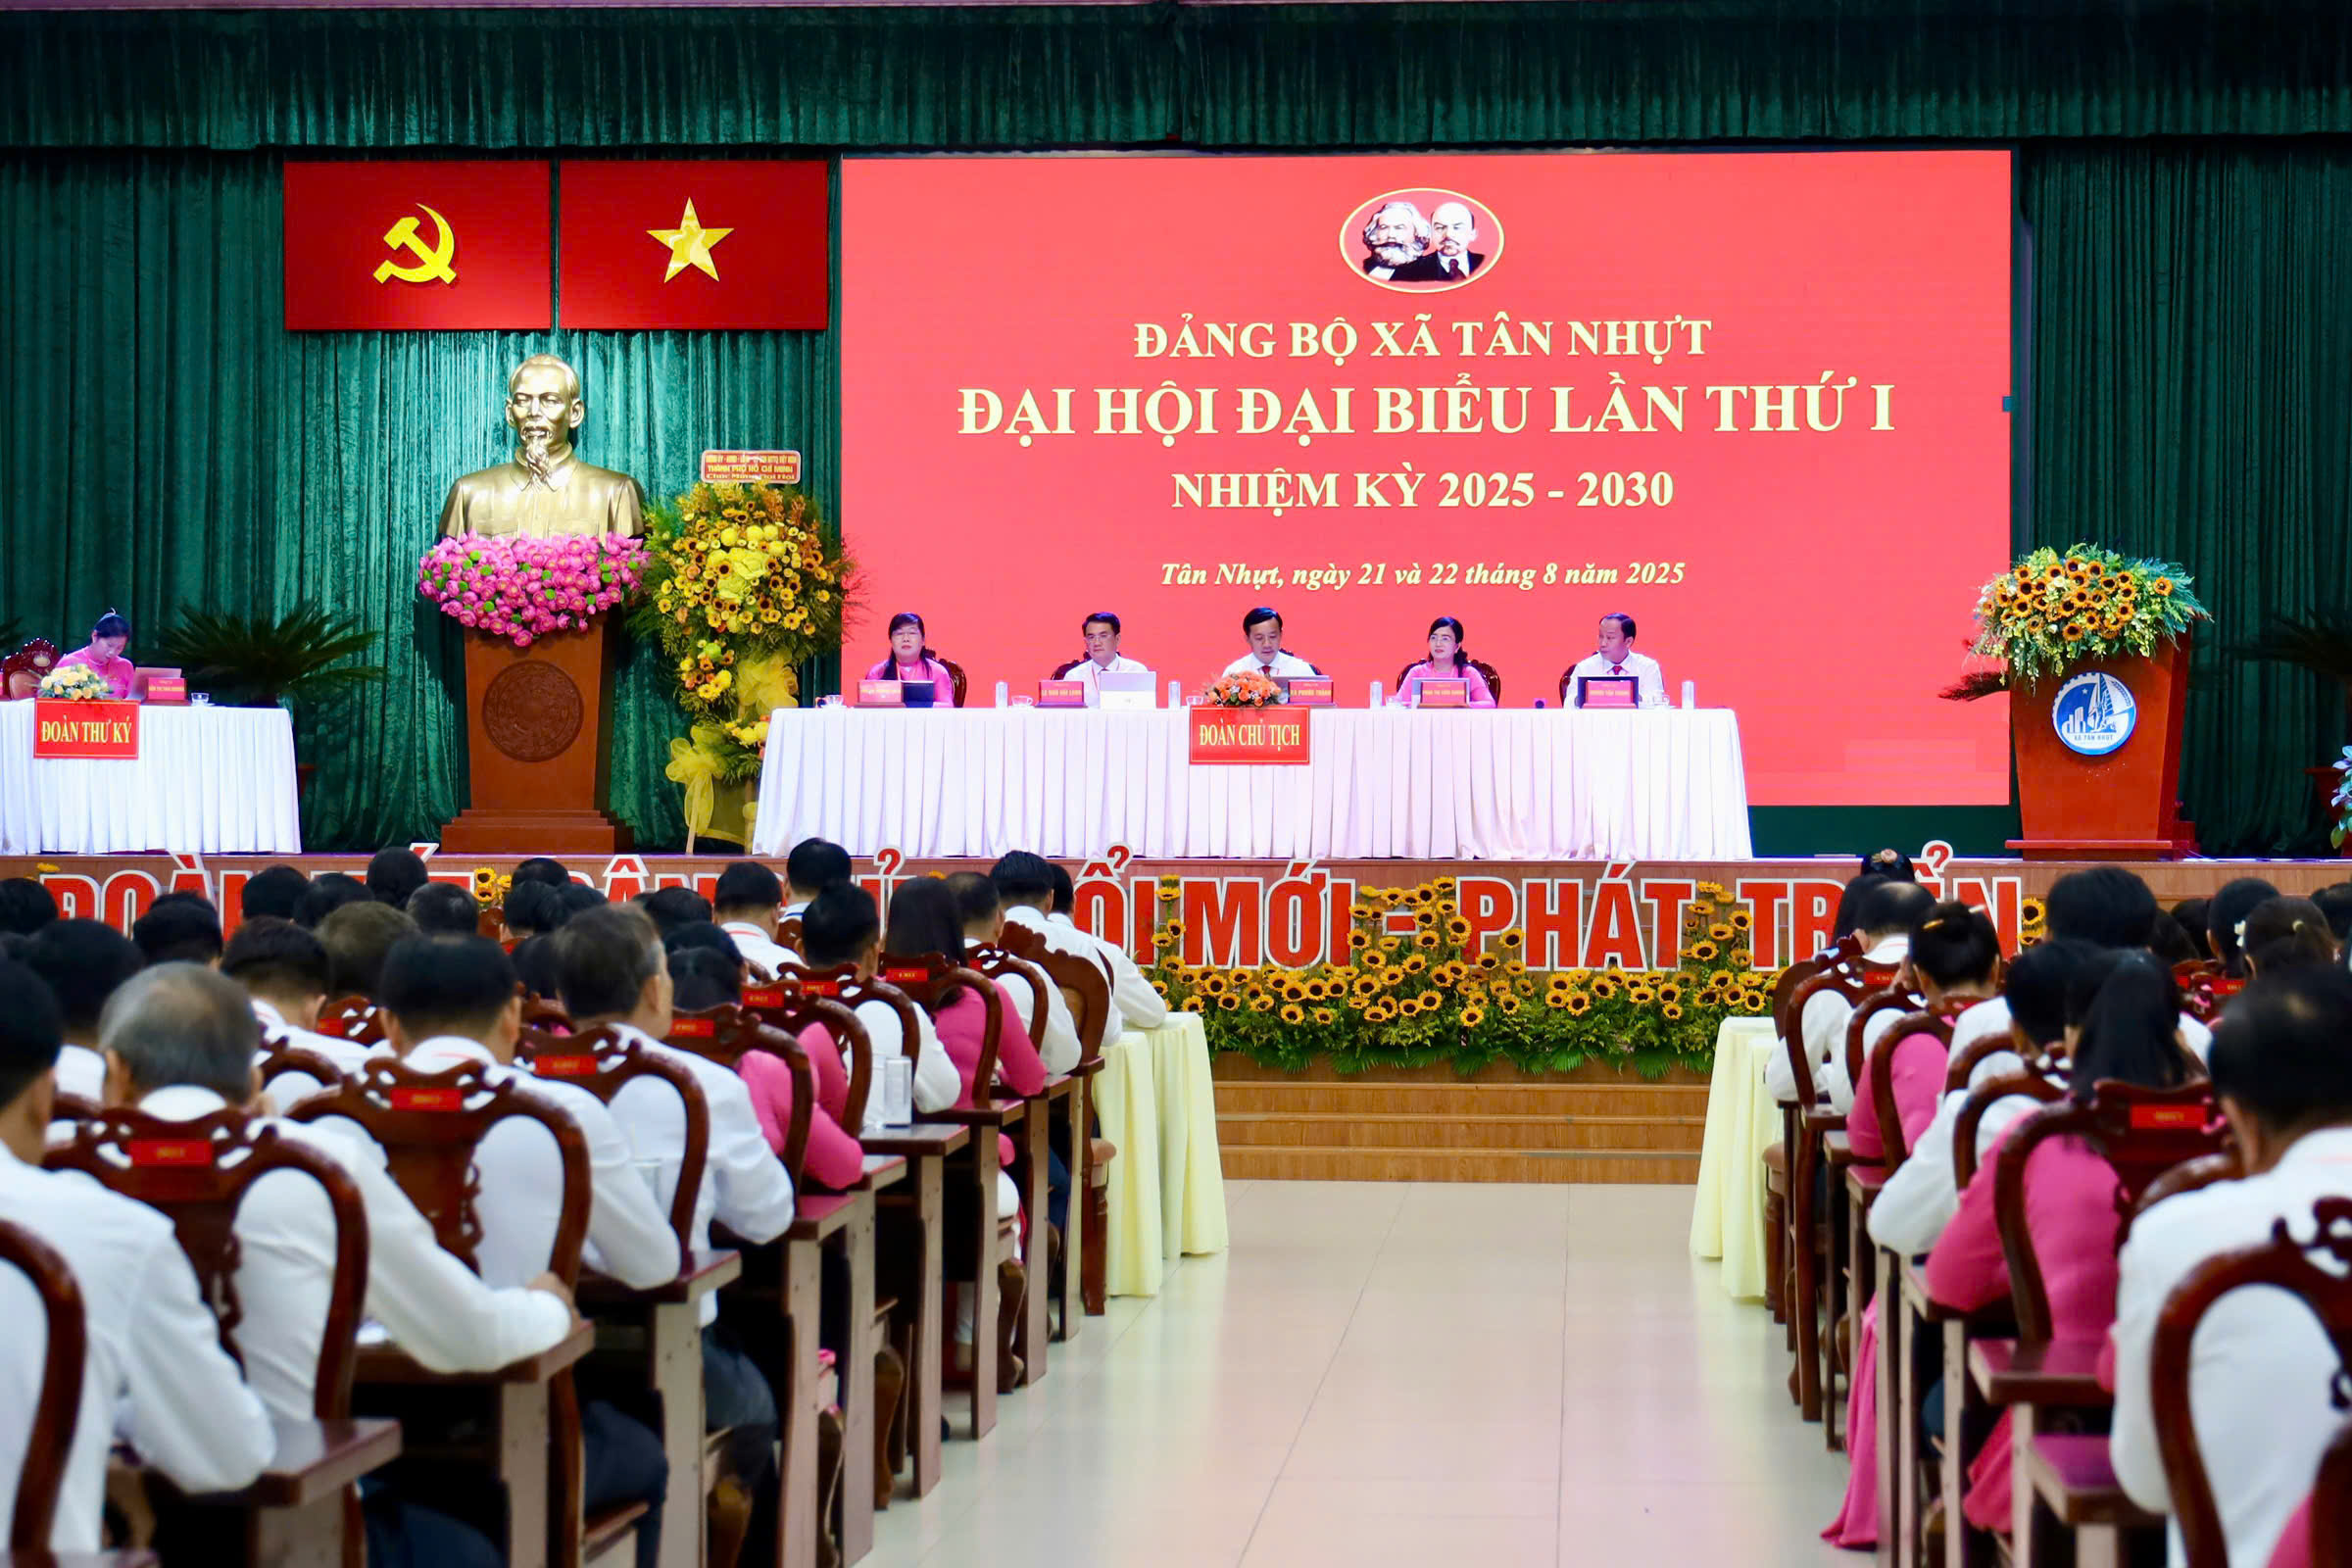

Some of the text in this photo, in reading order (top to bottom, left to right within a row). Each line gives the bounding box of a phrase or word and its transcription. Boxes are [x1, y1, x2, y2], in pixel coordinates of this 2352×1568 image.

[1133, 311, 1712, 367] ĐẢNG BỘ XÃ TÂN NHỰT
[956, 369, 1895, 448] ĐẠI HỘI ĐẠI BIỂU LẦN THỨ I
[1171, 466, 1341, 517] NHIỆM
[1353, 462, 1427, 508] KỲ
[1438, 471, 1535, 508] 2025
[1576, 470, 1674, 507] 2030
[1161, 562, 1687, 591] Tân Nhựt, ngày 21 và 22 tháng 8 năm 2025
[41, 714, 132, 744] ĐOÀN THƯ KÝ
[1199, 717, 1300, 752] ĐOÀN CHỦ TỊCH
[1073, 841, 1159, 969] ỔI
[1180, 858, 1356, 970] MỚI
[1455, 859, 1696, 972] PHÁT
[1736, 840, 2022, 971] TRN
